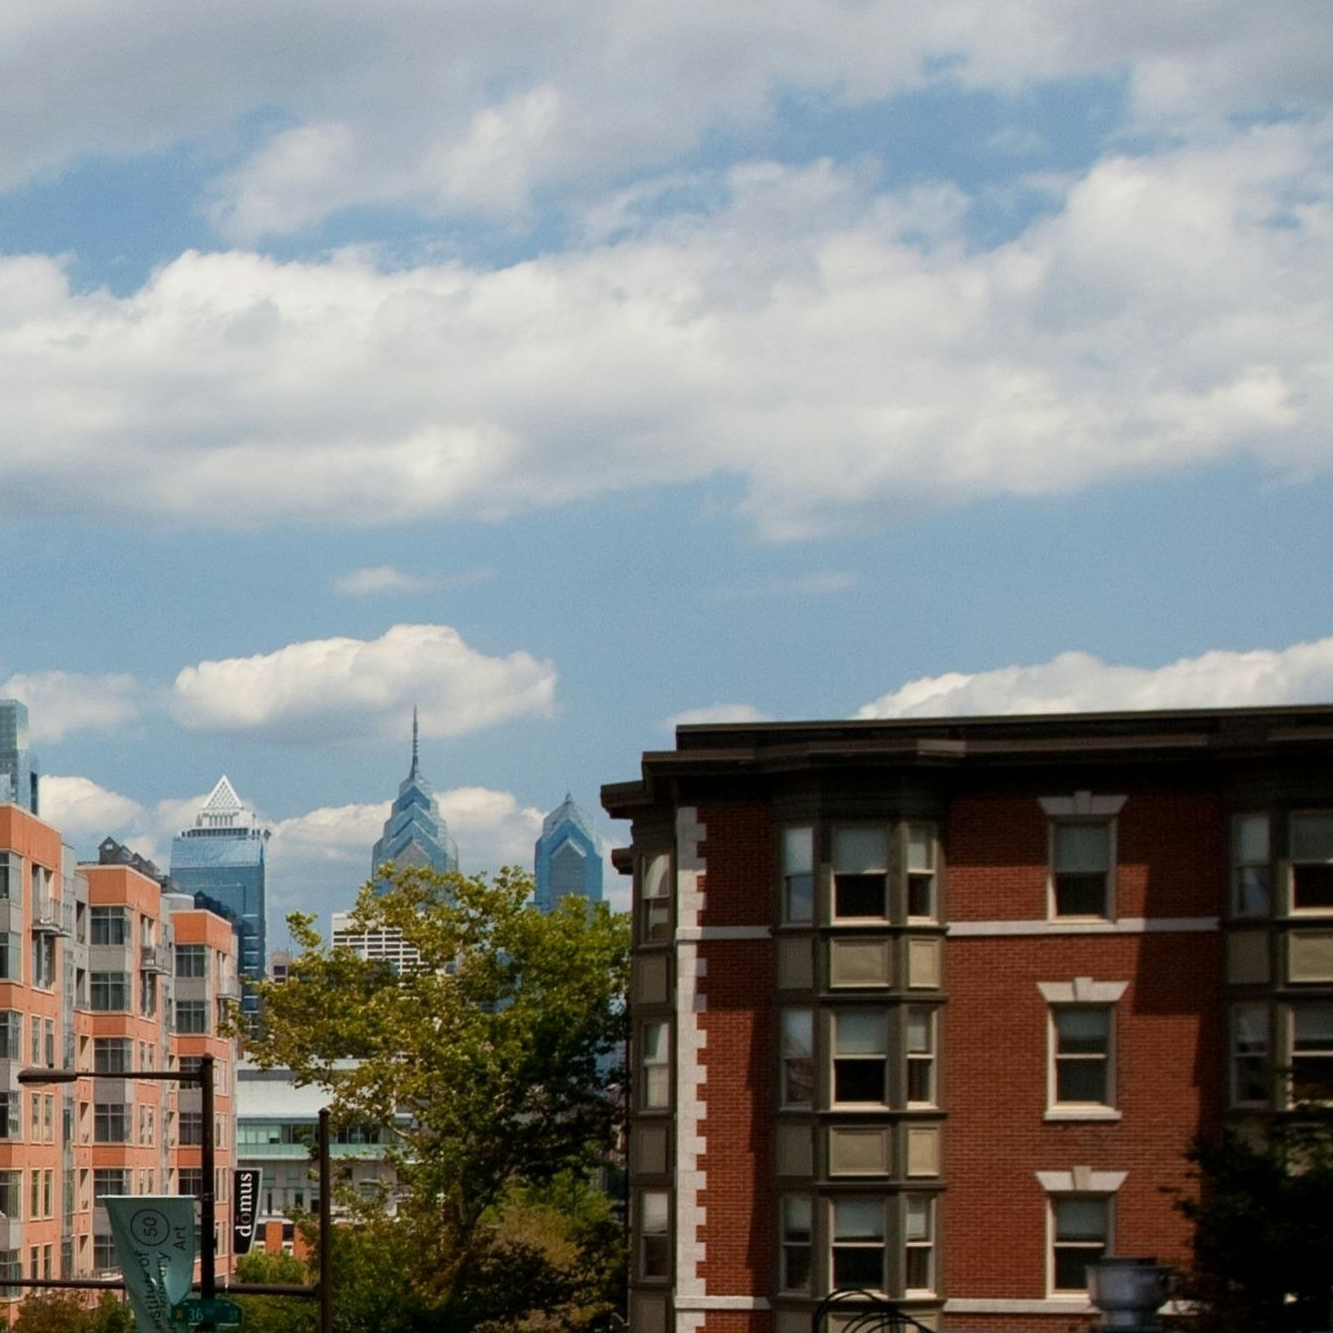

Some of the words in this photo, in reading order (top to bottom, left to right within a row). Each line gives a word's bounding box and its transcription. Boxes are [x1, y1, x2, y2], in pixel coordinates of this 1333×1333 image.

[143, 1217, 158, 1237] 50
[173, 1226, 186, 1251] Art
[134, 1250, 150, 1266] of
